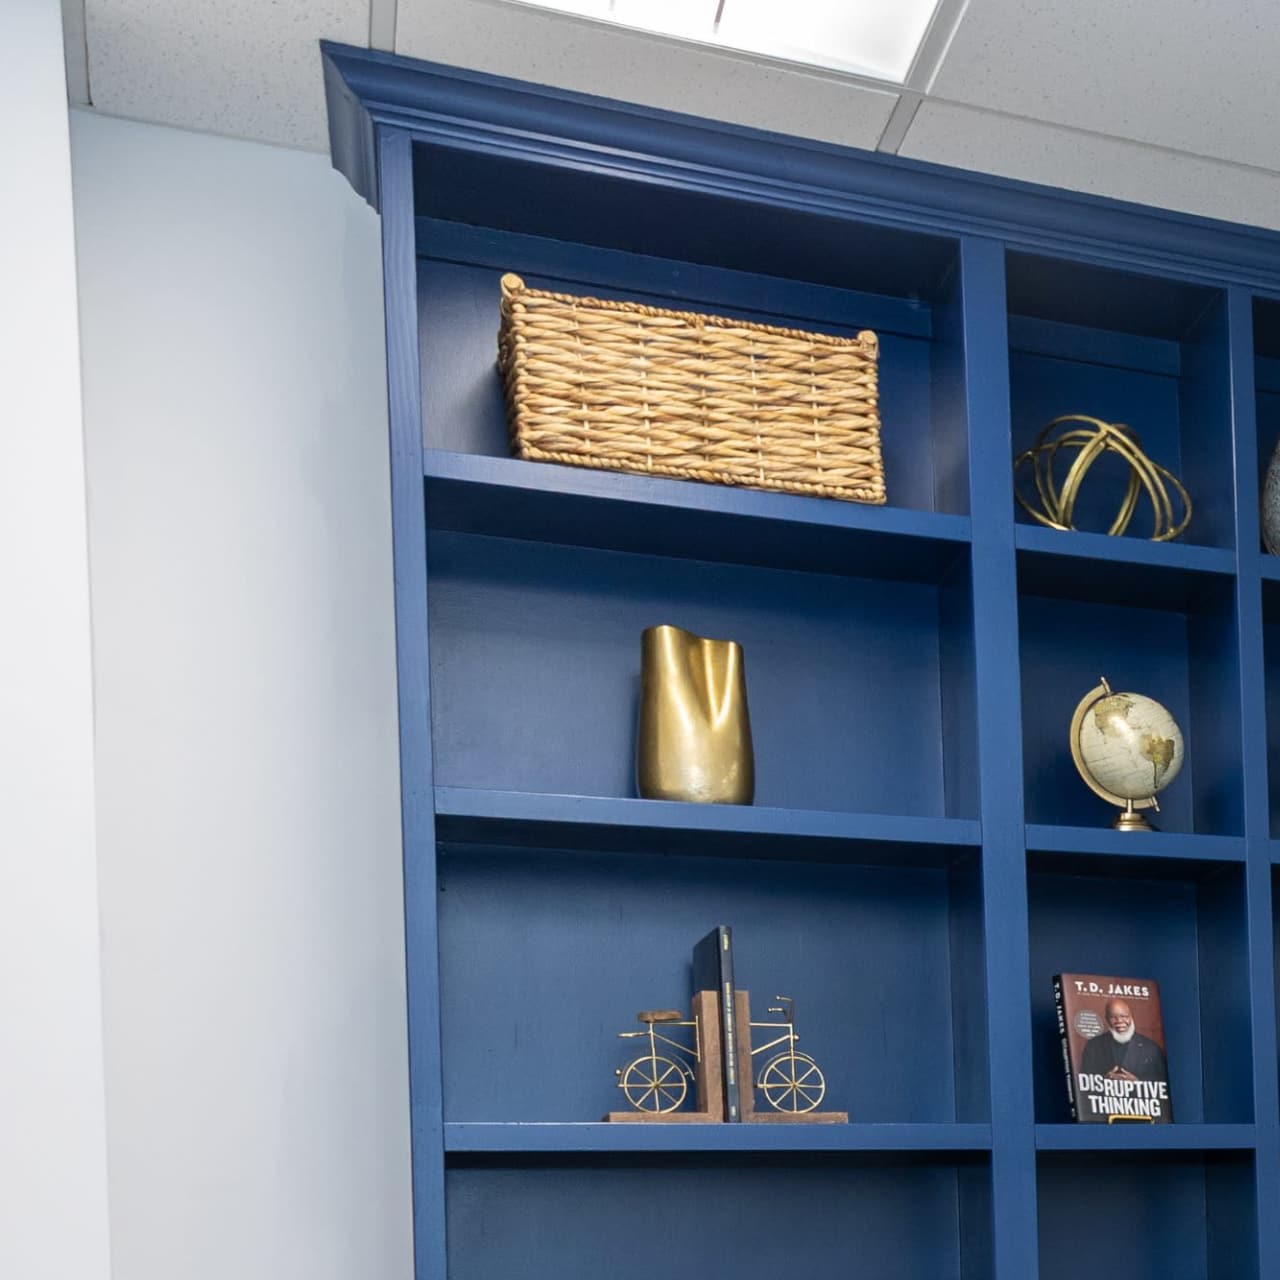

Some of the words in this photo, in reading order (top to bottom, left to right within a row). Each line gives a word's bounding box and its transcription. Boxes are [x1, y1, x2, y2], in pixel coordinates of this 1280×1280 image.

[1075, 981, 1103, 993] T.D.
[1108, 984, 1149, 997] JAKES
[1078, 1073, 1169, 1100] DISRUPTIVE
[1088, 1095, 1162, 1117] THINKING
